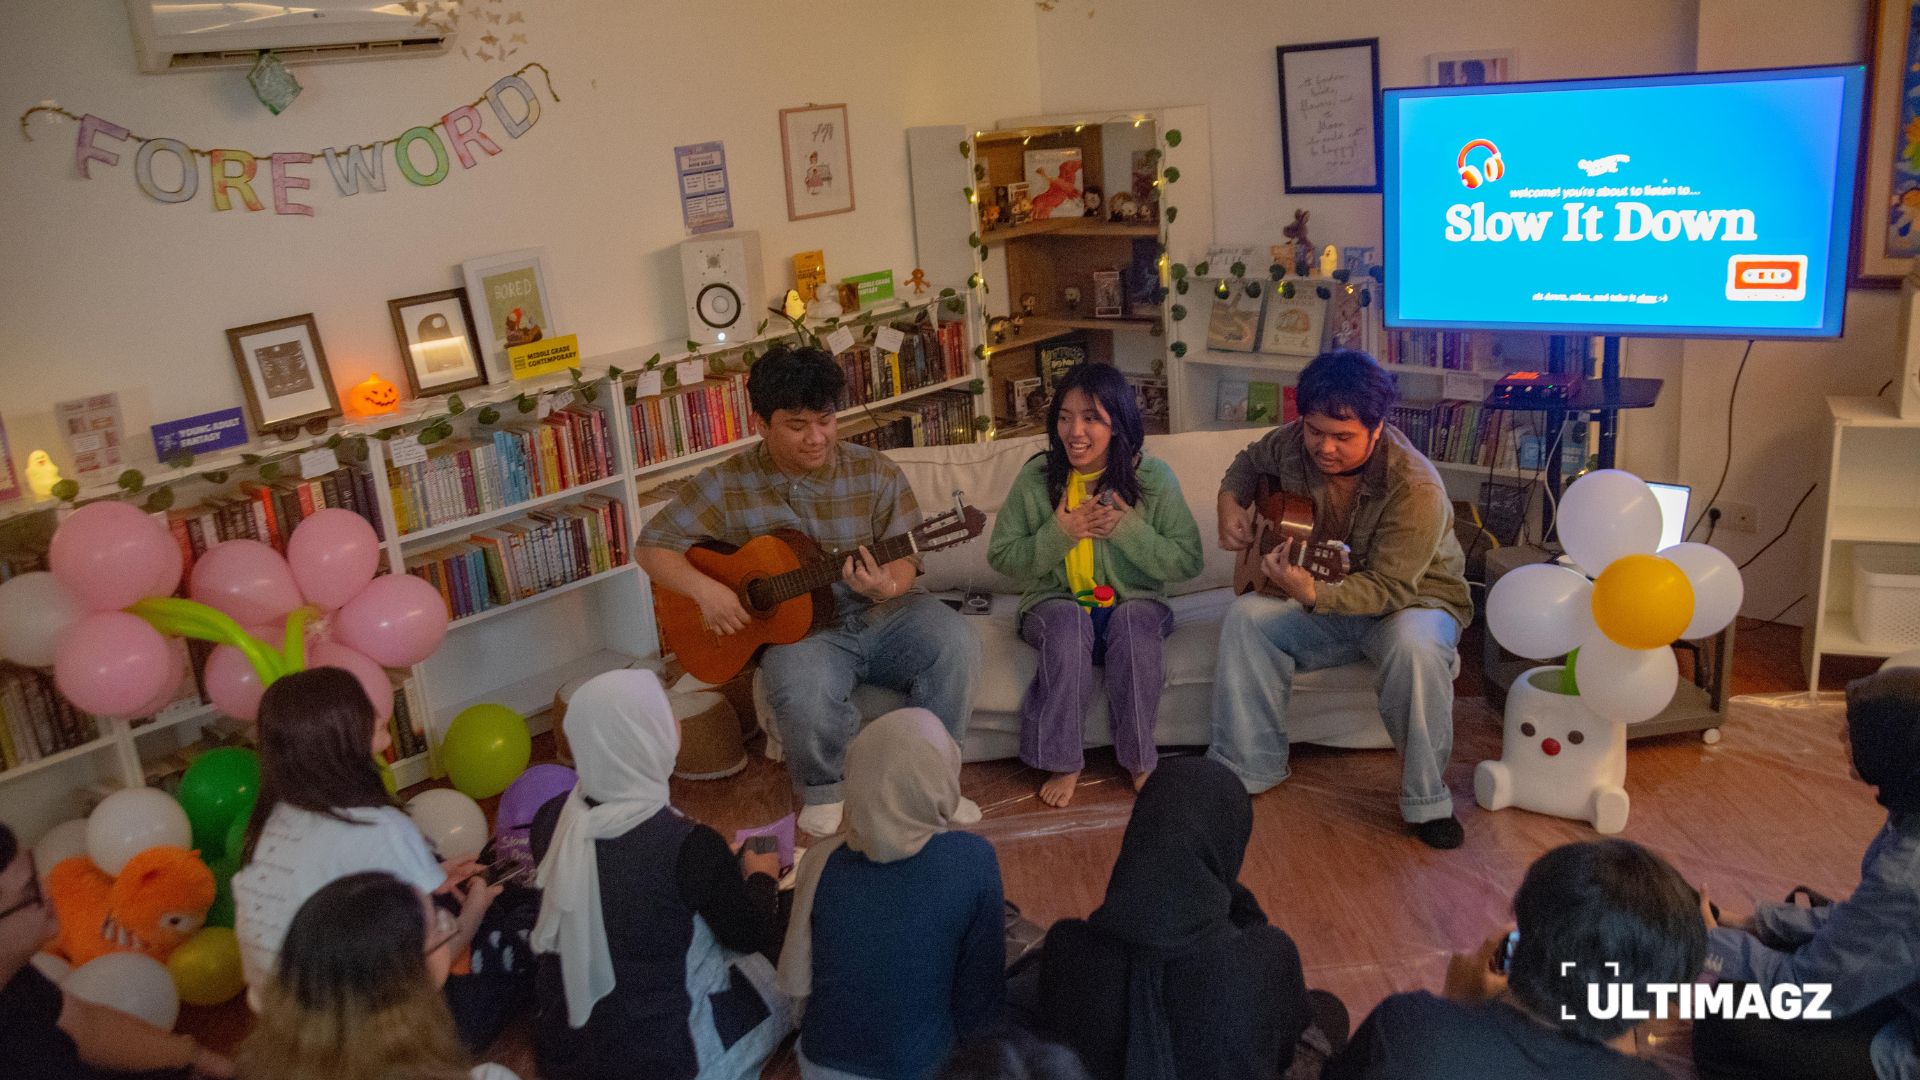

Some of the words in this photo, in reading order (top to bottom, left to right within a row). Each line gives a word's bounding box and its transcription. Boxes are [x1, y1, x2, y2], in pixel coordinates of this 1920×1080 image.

[76, 75, 541, 217] FOREWORD
[1510, 187, 1561, 198] welcome!
[1596, 186, 1629, 198] about
[1629, 186, 1643, 197] to
[1644, 185, 1676, 196] listen
[1445, 202, 1553, 242] Slow
[1562, 202, 1604, 242] It
[1613, 202, 1758, 242] Down
[494, 278, 532, 300] BORED
[527, 348, 550, 360] MIDDLE
[551, 345, 570, 354] GRADE
[528, 352, 577, 368] CONTEMPORARY
[178, 424, 212, 438] YOUNG
[212, 417, 240, 431] ADULT
[180, 431, 221, 448] FANTASY
